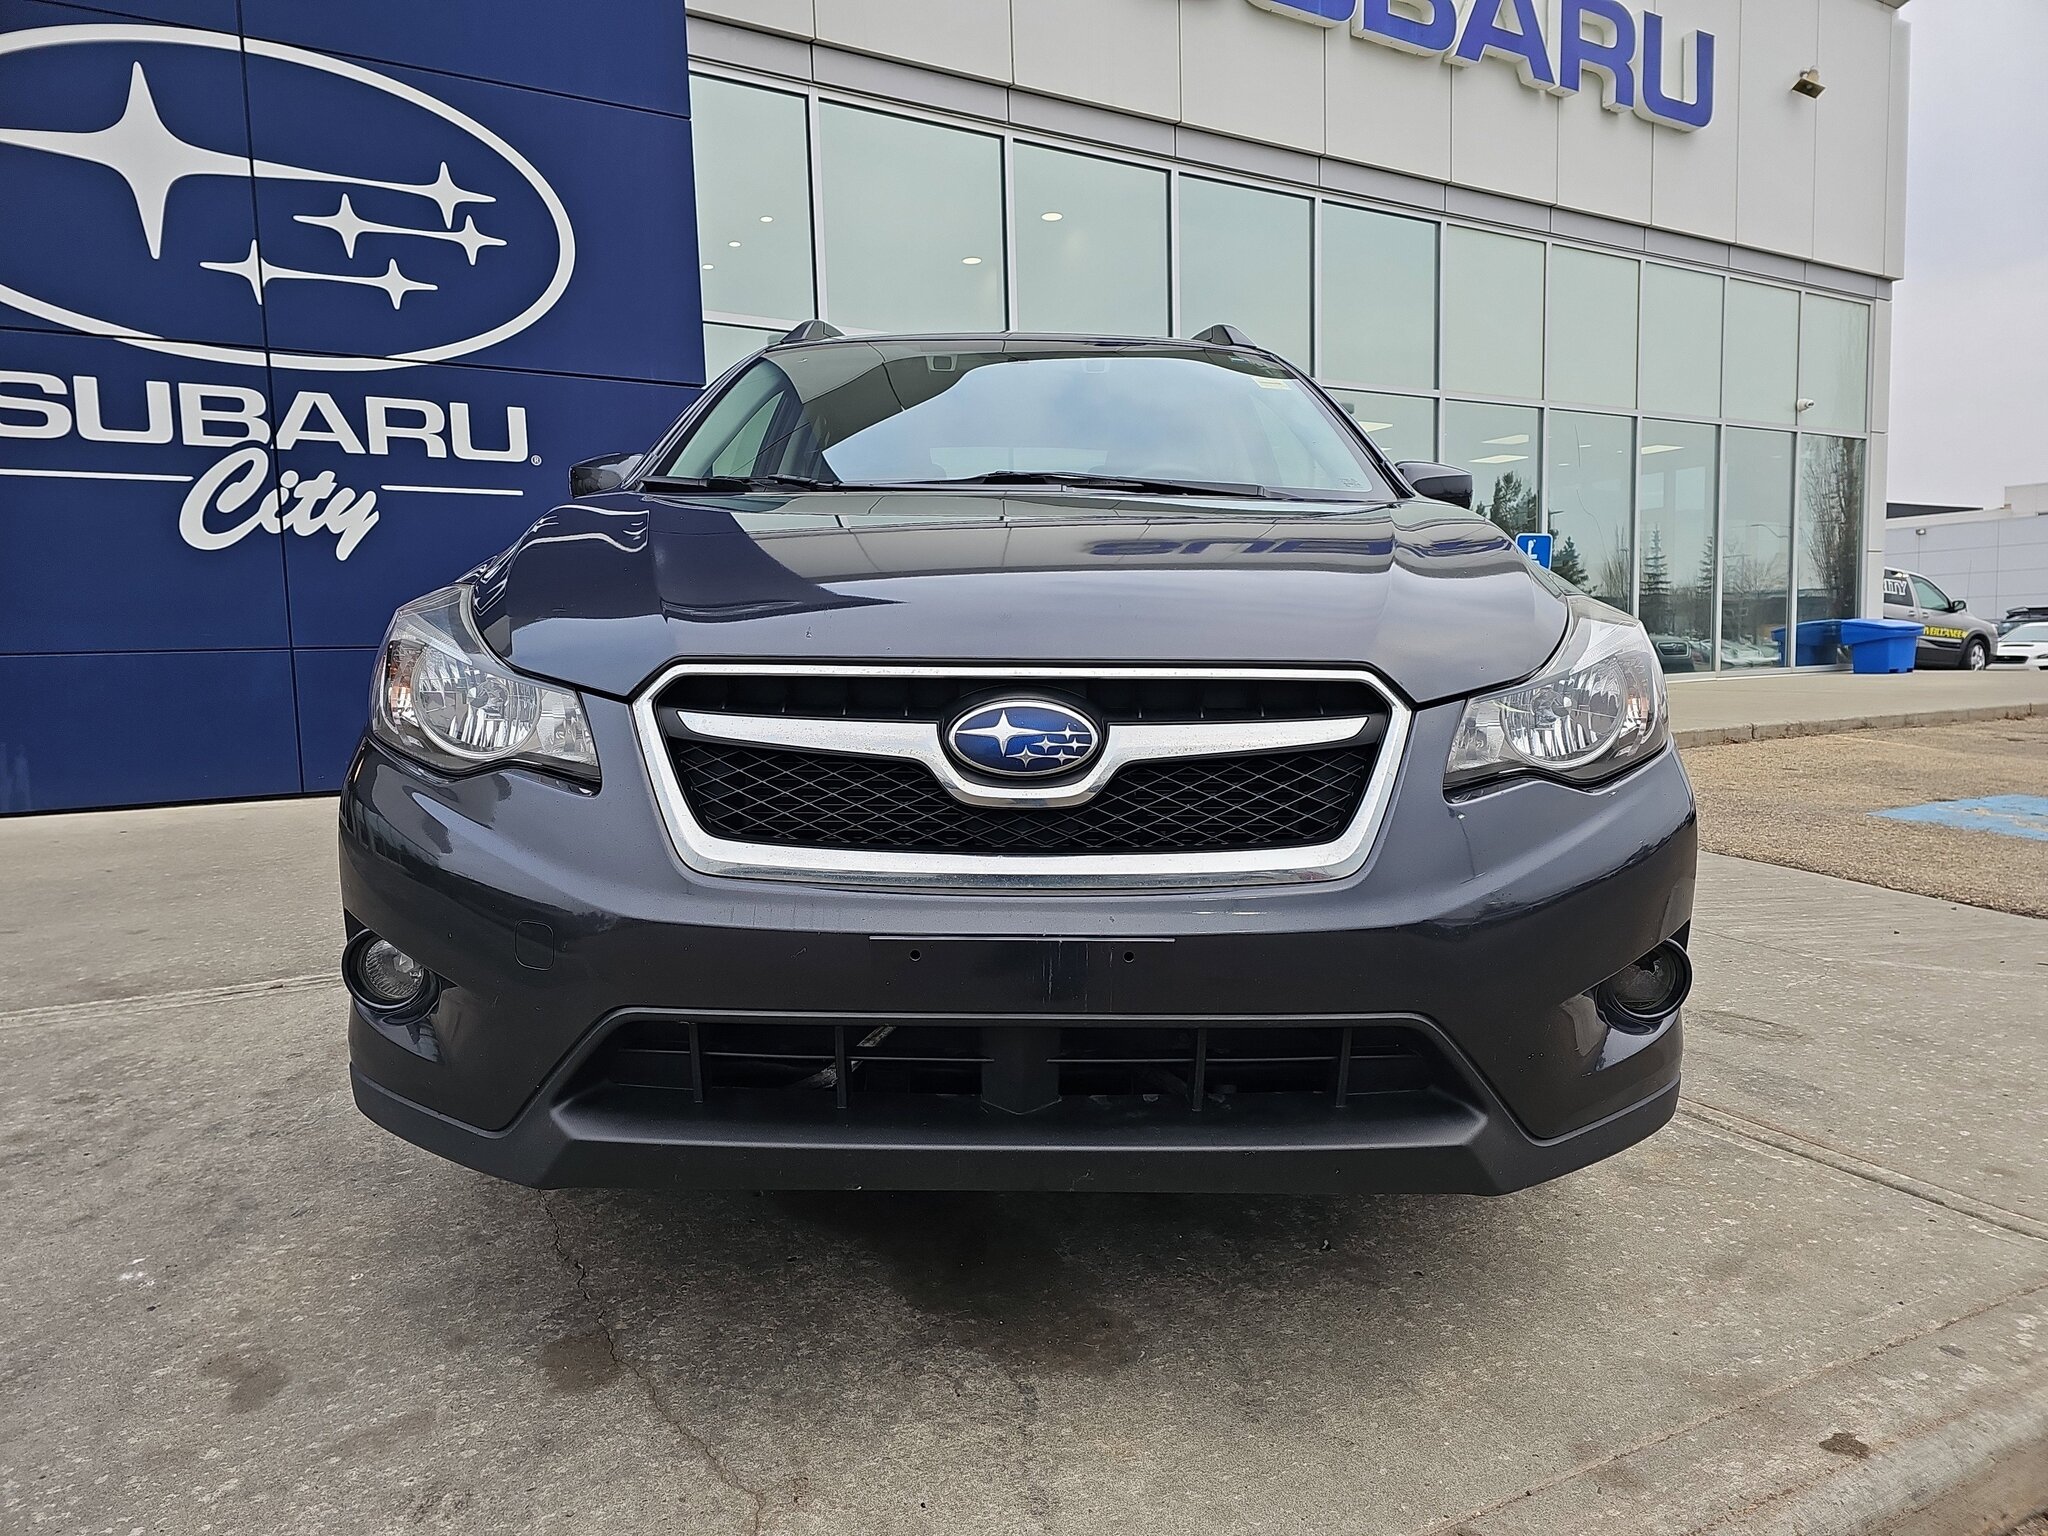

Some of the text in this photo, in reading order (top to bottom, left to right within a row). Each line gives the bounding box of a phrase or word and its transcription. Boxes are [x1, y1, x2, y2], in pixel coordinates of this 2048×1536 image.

[1245, 0, 1715, 132] ARU
[0, 371, 528, 462] SUBARU
[179, 447, 380, 561] City
